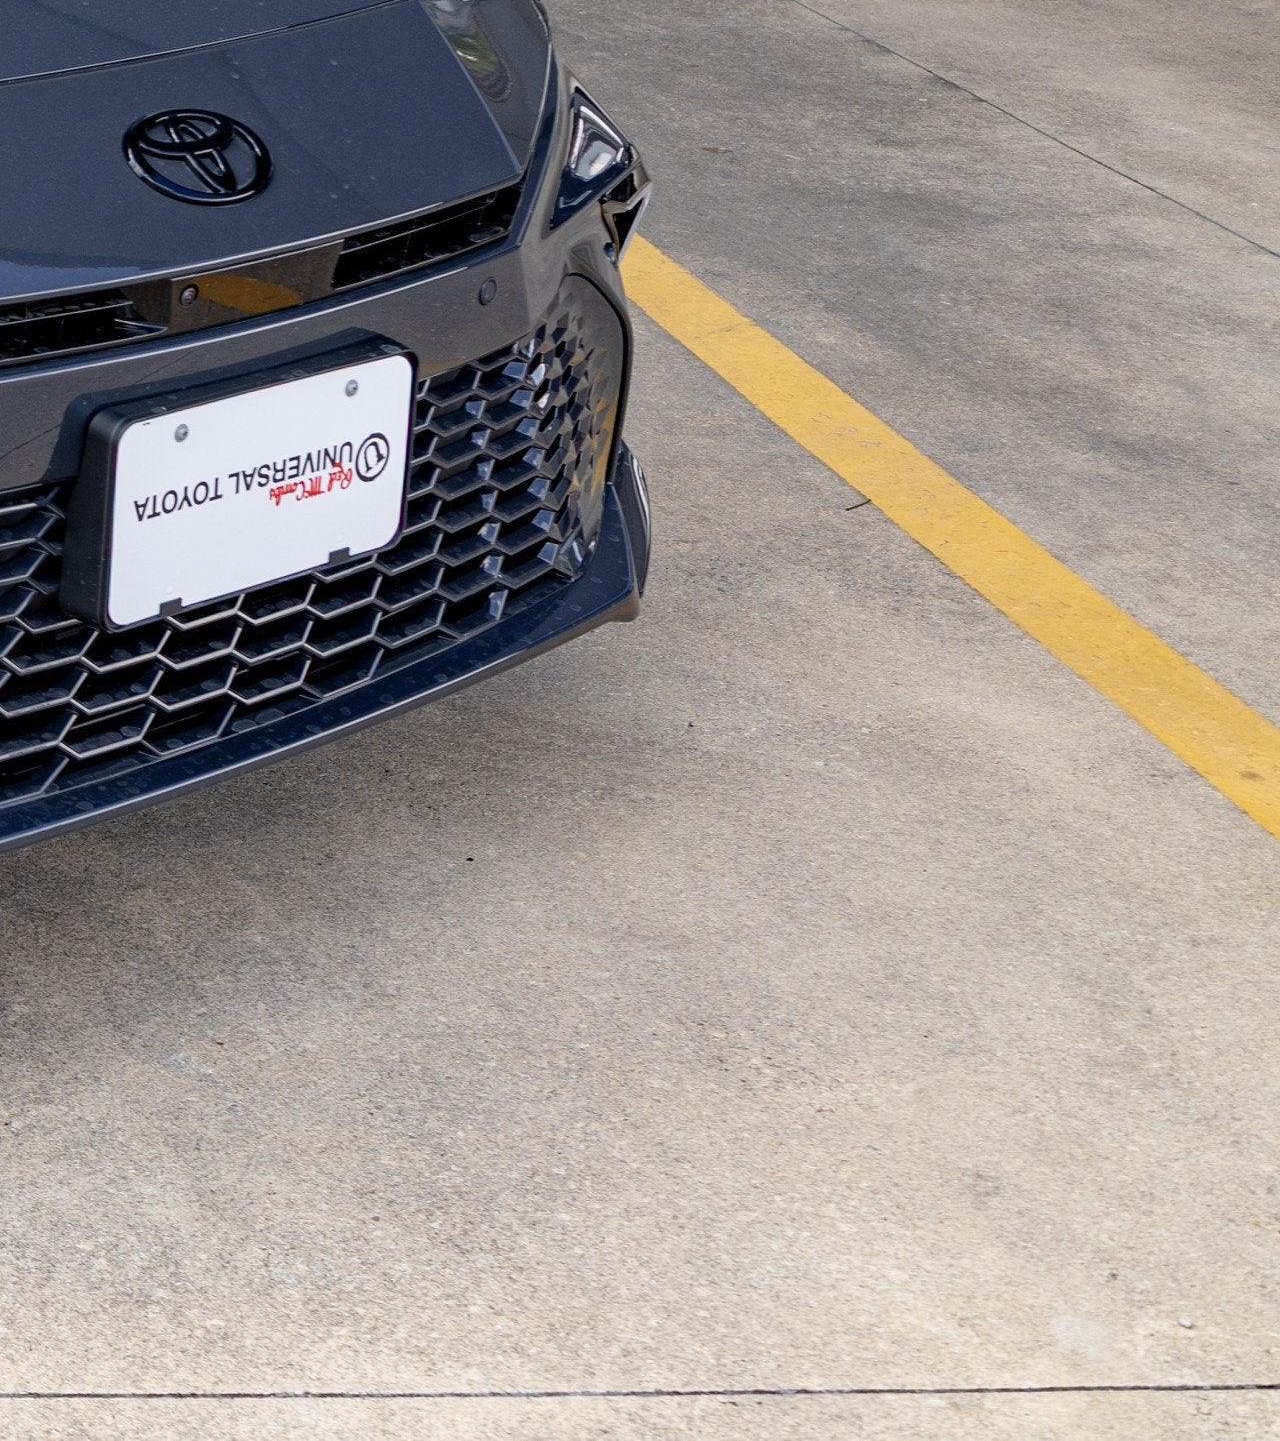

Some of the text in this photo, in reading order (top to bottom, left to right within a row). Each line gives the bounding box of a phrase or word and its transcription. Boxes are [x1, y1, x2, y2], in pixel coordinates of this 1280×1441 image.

[133, 441, 353, 522] UNIVERSAL TOYOTA
[327, 462, 353, 493] Red
